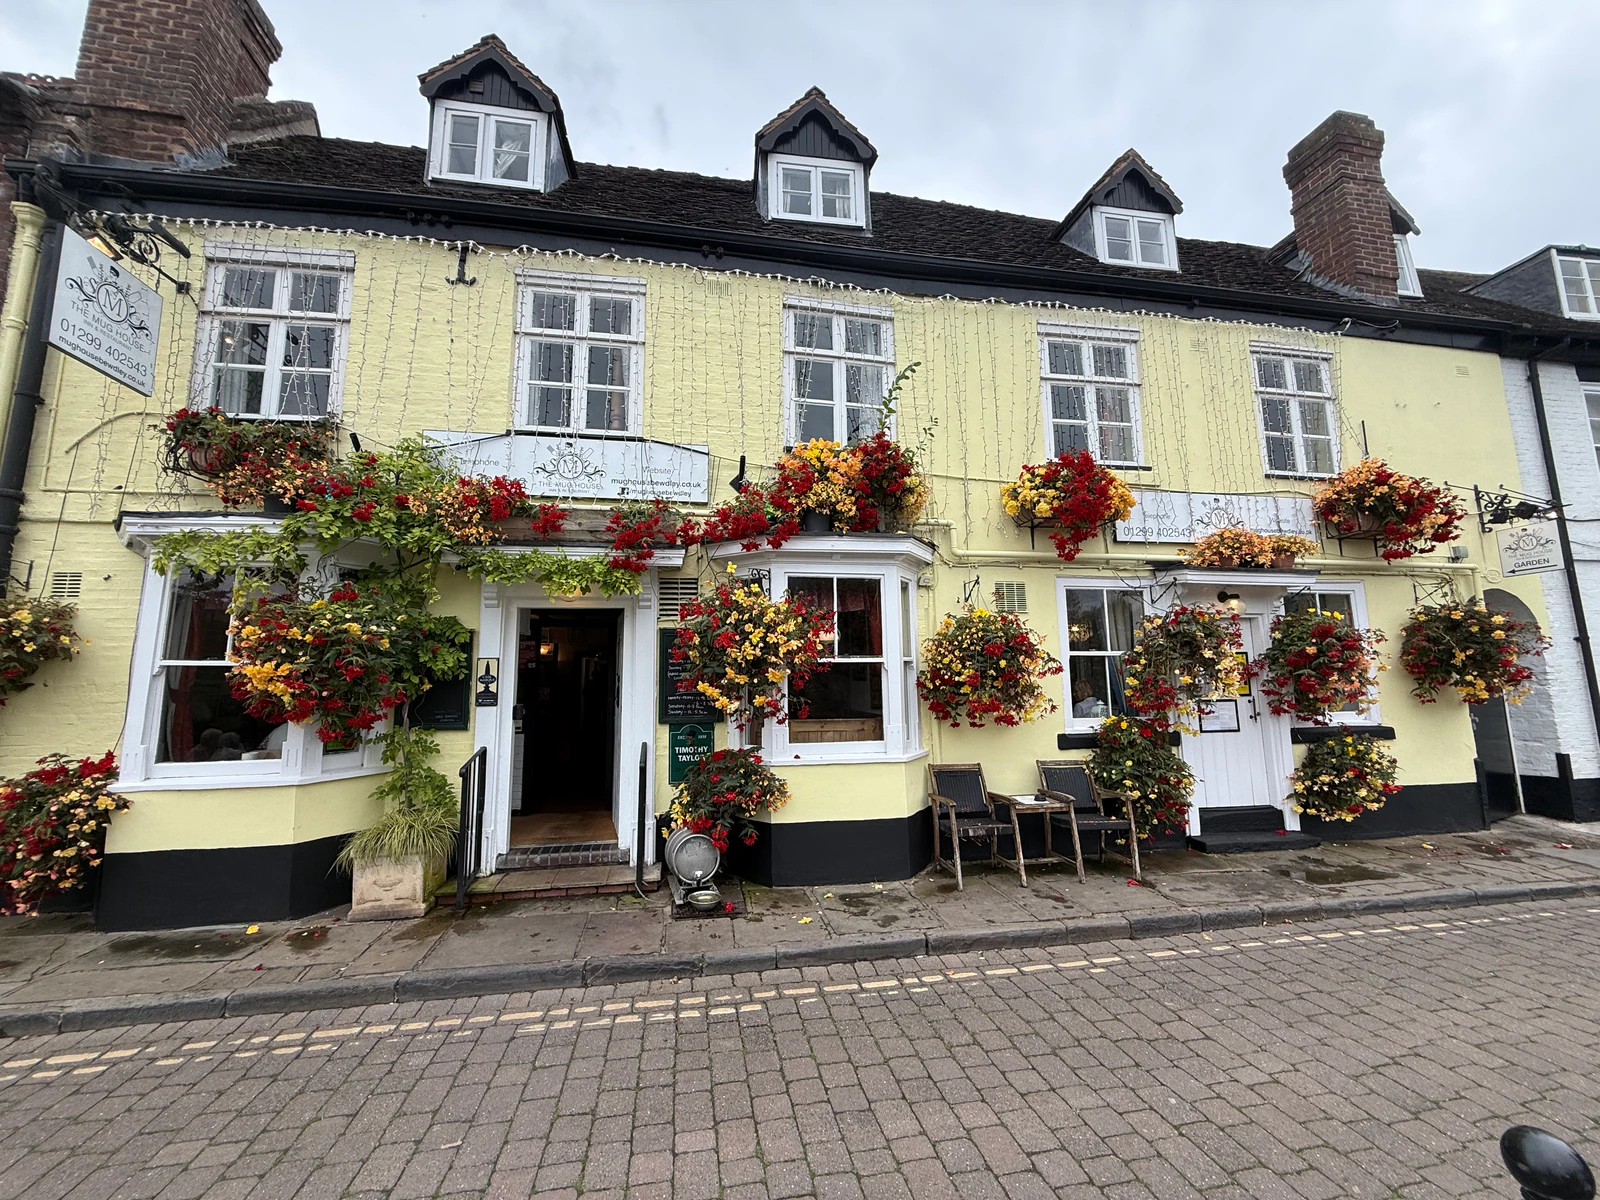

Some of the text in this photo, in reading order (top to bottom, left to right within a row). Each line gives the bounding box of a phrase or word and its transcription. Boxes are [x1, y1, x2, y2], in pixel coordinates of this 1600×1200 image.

[103, 287, 122, 318] M
[71, 300, 144, 352] THE MUG HOUSE
[60, 318, 148, 377] 01299 402543
[58, 335, 146, 388] mughousebewdley.co.uk
[555, 481, 572, 489] MUG
[574, 482, 601, 490] HOUSE
[1123, 526, 1192, 538] 01299 402543
[1522, 537, 1534, 548] M
[1514, 558, 1550, 568] GARDEN
[677, 754, 704, 762] TAYLO
